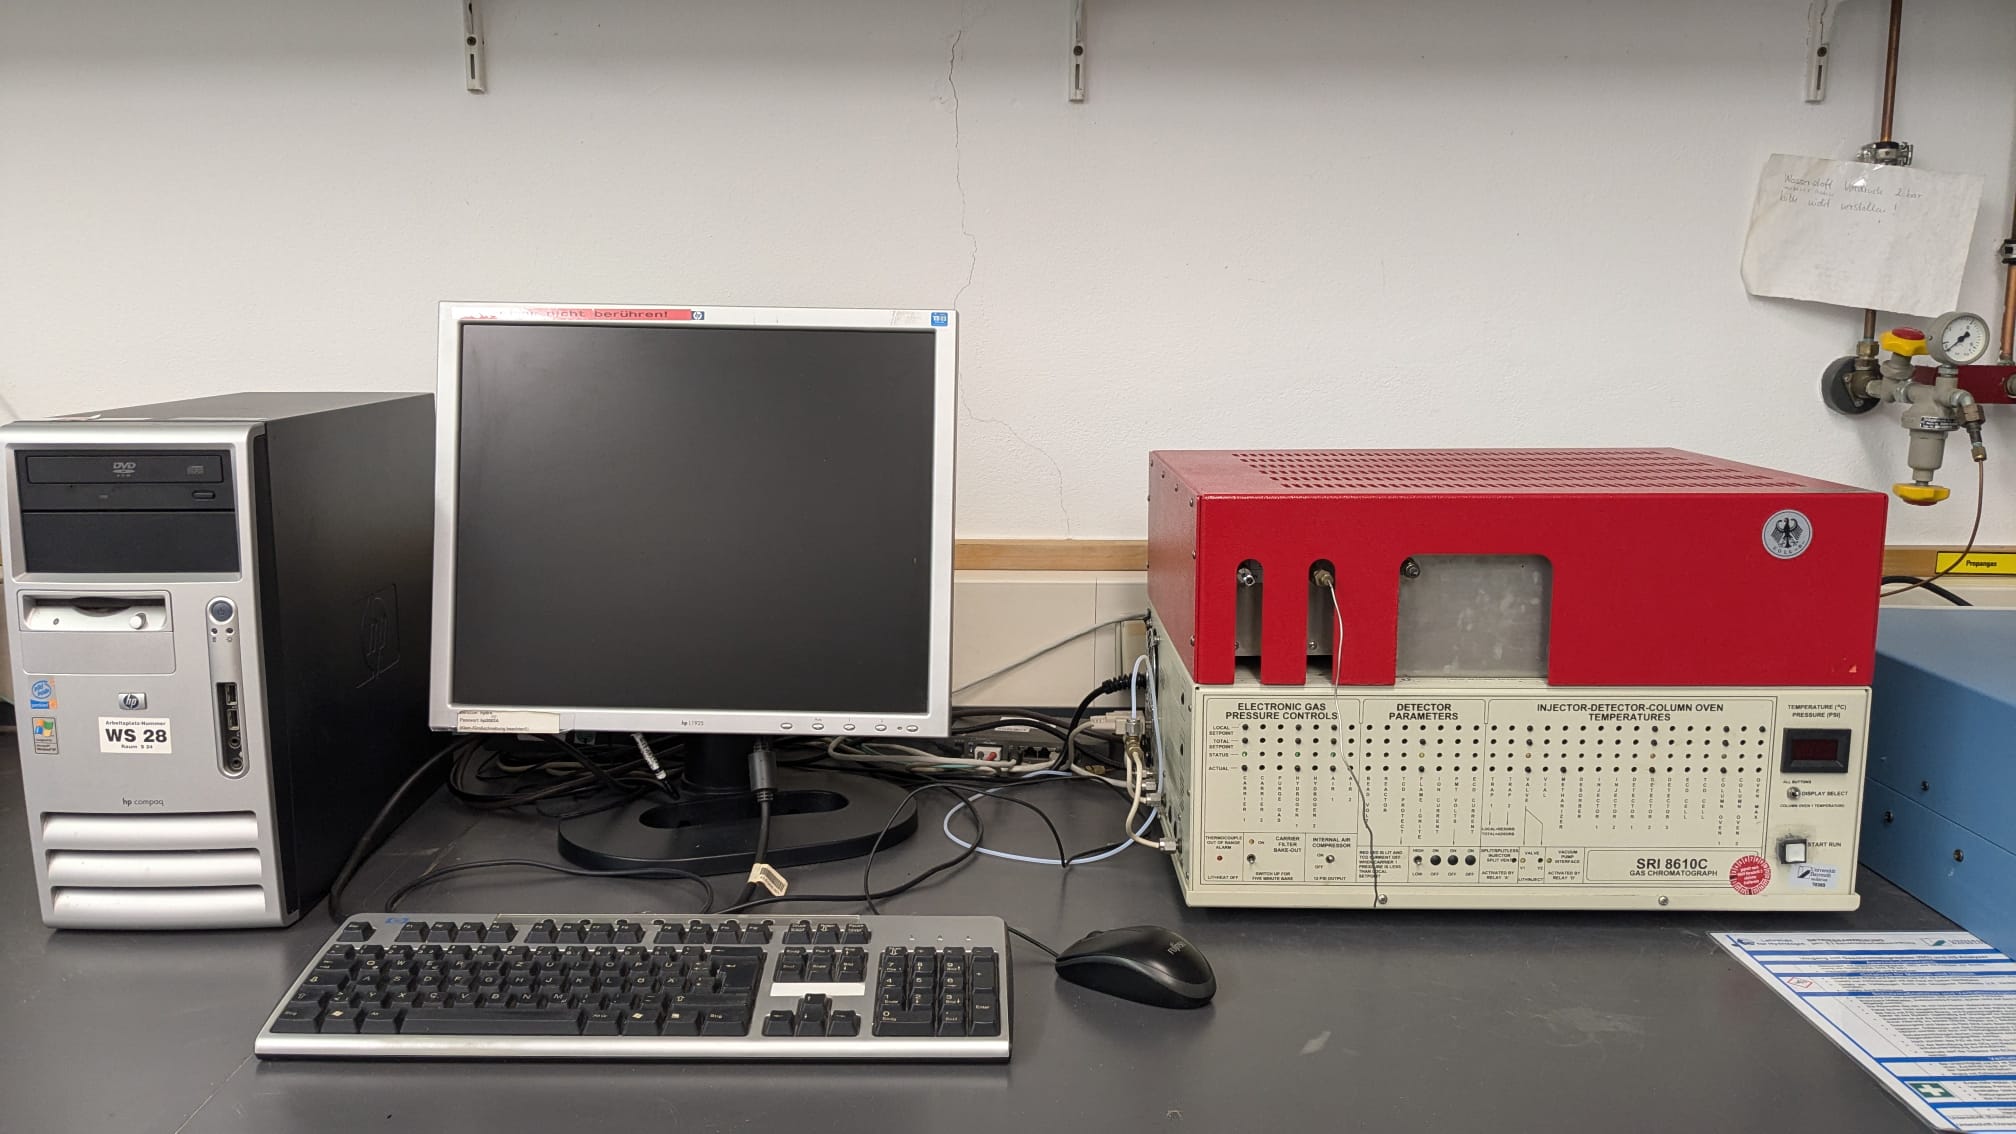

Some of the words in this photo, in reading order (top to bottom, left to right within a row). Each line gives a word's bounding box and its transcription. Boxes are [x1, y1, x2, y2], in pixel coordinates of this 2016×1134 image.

[594, 310, 668, 319] berühren!
[1966, 560, 1997, 568] Propangas
[1537, 704, 1692, 712] INJECTOR-DETECTOR-COLUMN
[1695, 704, 1724, 712] OVEN
[1226, 712, 1279, 720] PRESSURE
[1283, 712, 1338, 720] CONTROLS
[1589, 713, 1671, 721] TEMPERATURES
[105, 729, 136, 742] WS
[143, 729, 167, 742] 28
[123, 798, 132, 806] hp
[1636, 858, 1660, 869] SRI
[1665, 858, 1708, 869] 8610C
